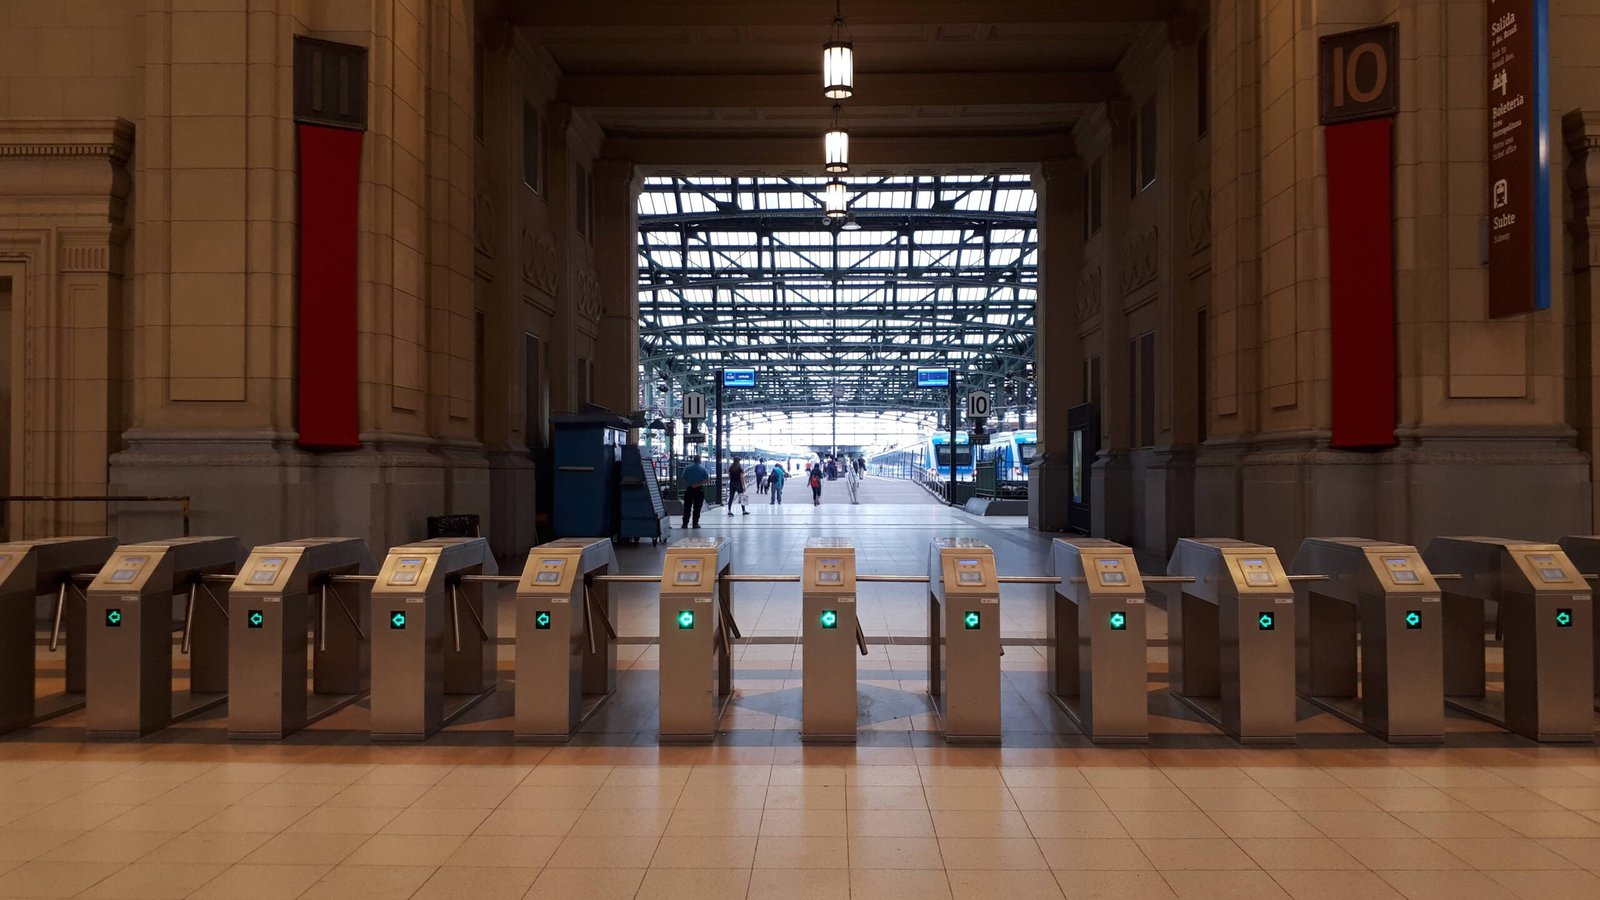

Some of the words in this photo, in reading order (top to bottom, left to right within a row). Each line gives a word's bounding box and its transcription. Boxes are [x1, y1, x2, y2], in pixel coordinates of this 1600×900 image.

[1491, 12, 1516, 36] Salida
[1334, 42, 1387, 108] 10
[1493, 213, 1516, 230] Subte
[971, 396, 987, 415] 10
